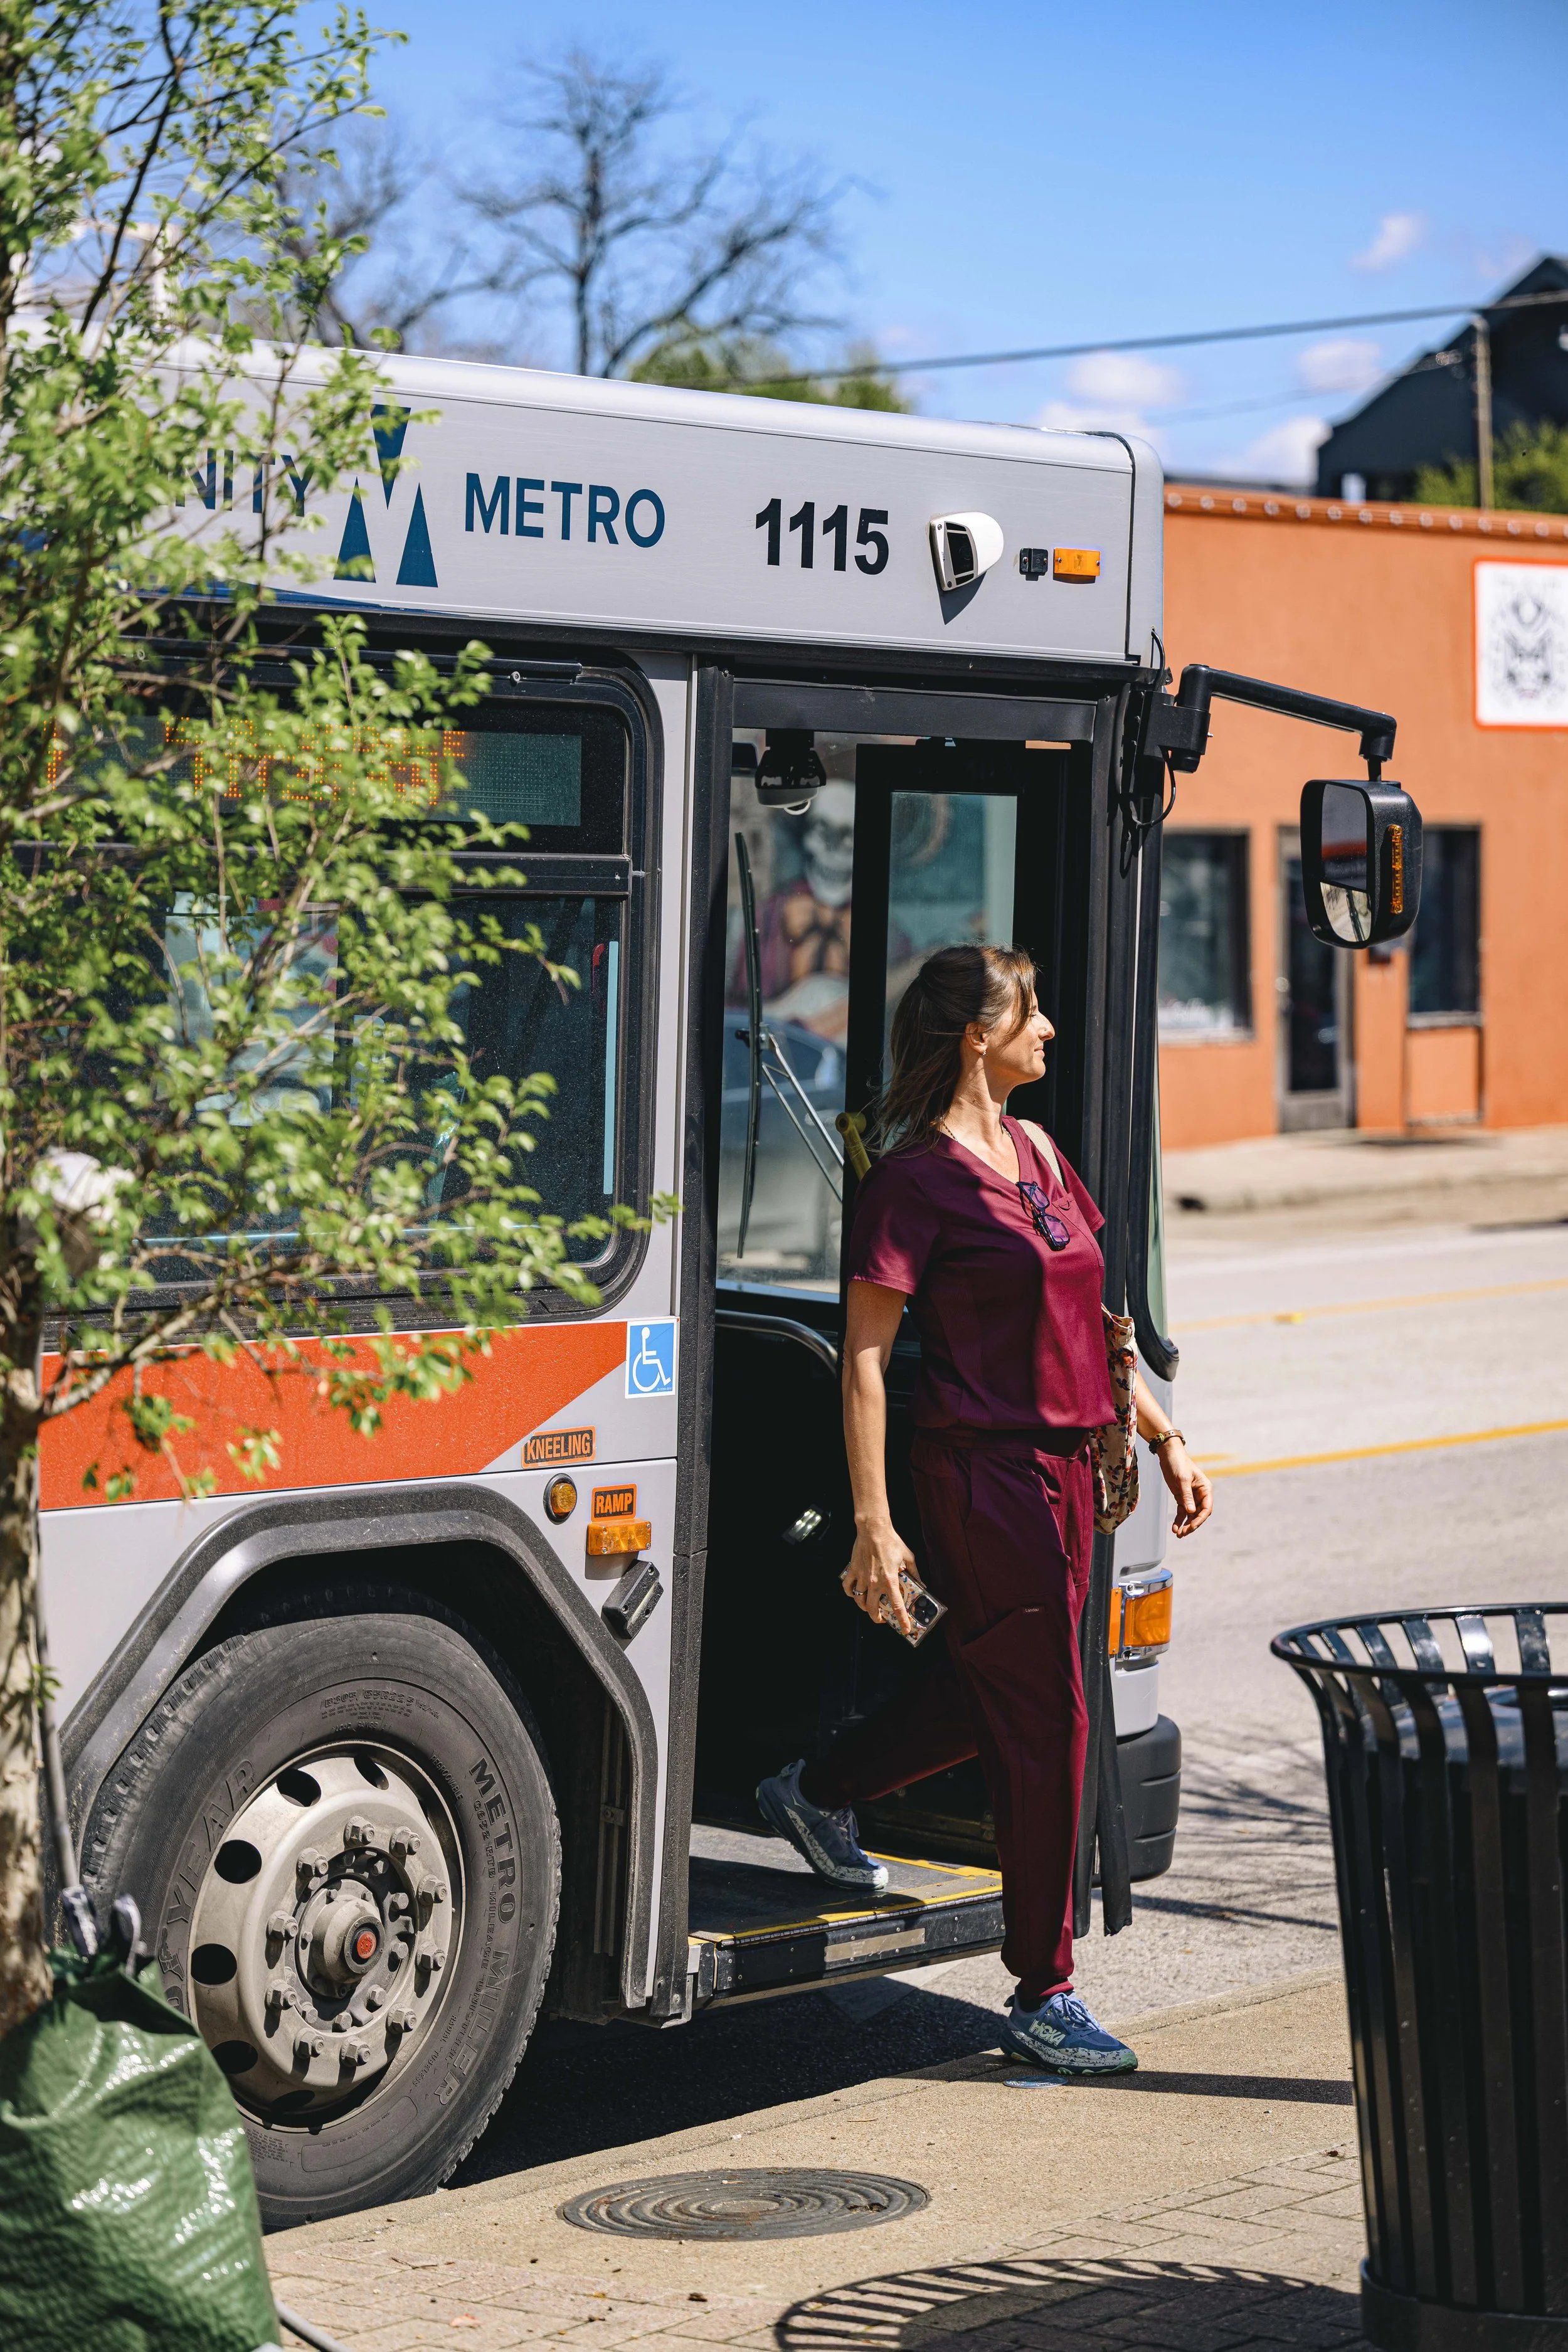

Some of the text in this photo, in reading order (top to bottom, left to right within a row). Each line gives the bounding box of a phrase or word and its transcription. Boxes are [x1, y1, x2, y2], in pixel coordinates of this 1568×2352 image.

[465, 472, 665, 548] METRO
[755, 499, 889, 575] 1115
[527, 1433, 591, 1461] KNEELING
[596, 1493, 633, 1514] RAMP
[431, 1755, 464, 1801] REGROOVABLE
[469, 1757, 516, 1924] METRO
[474, 1799, 490, 1841] G652
[480, 1891, 497, 1969] MILEAGE
[440, 2015, 457, 2043] RADIAL
[1029, 2019, 1066, 2047] HOKA
